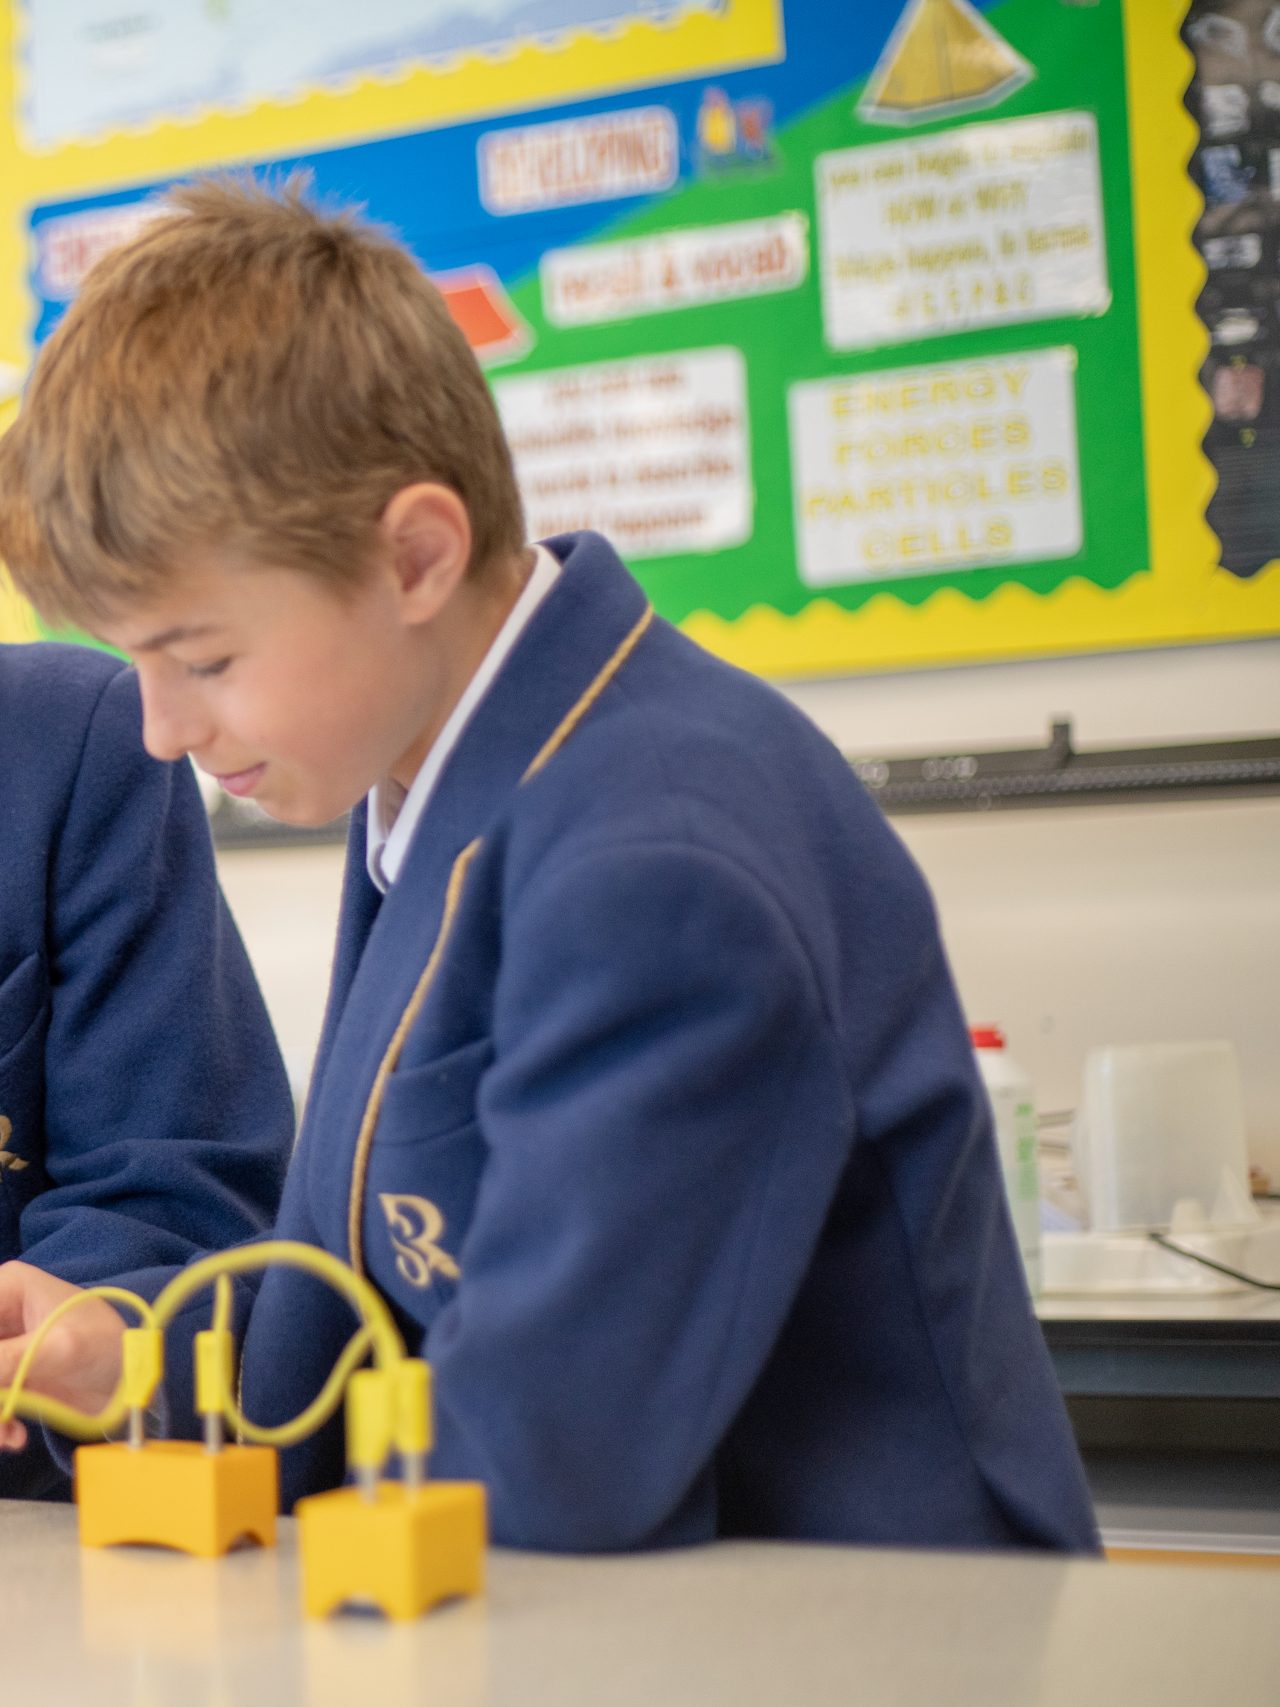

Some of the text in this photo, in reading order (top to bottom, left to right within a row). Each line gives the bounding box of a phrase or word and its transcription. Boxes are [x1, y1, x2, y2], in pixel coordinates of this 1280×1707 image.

[830, 366, 1029, 419] ENERGY
[833, 416, 1032, 466] FORCES
[804, 460, 1068, 520] PARTICLES
[861, 520, 1014, 567] CELLS
